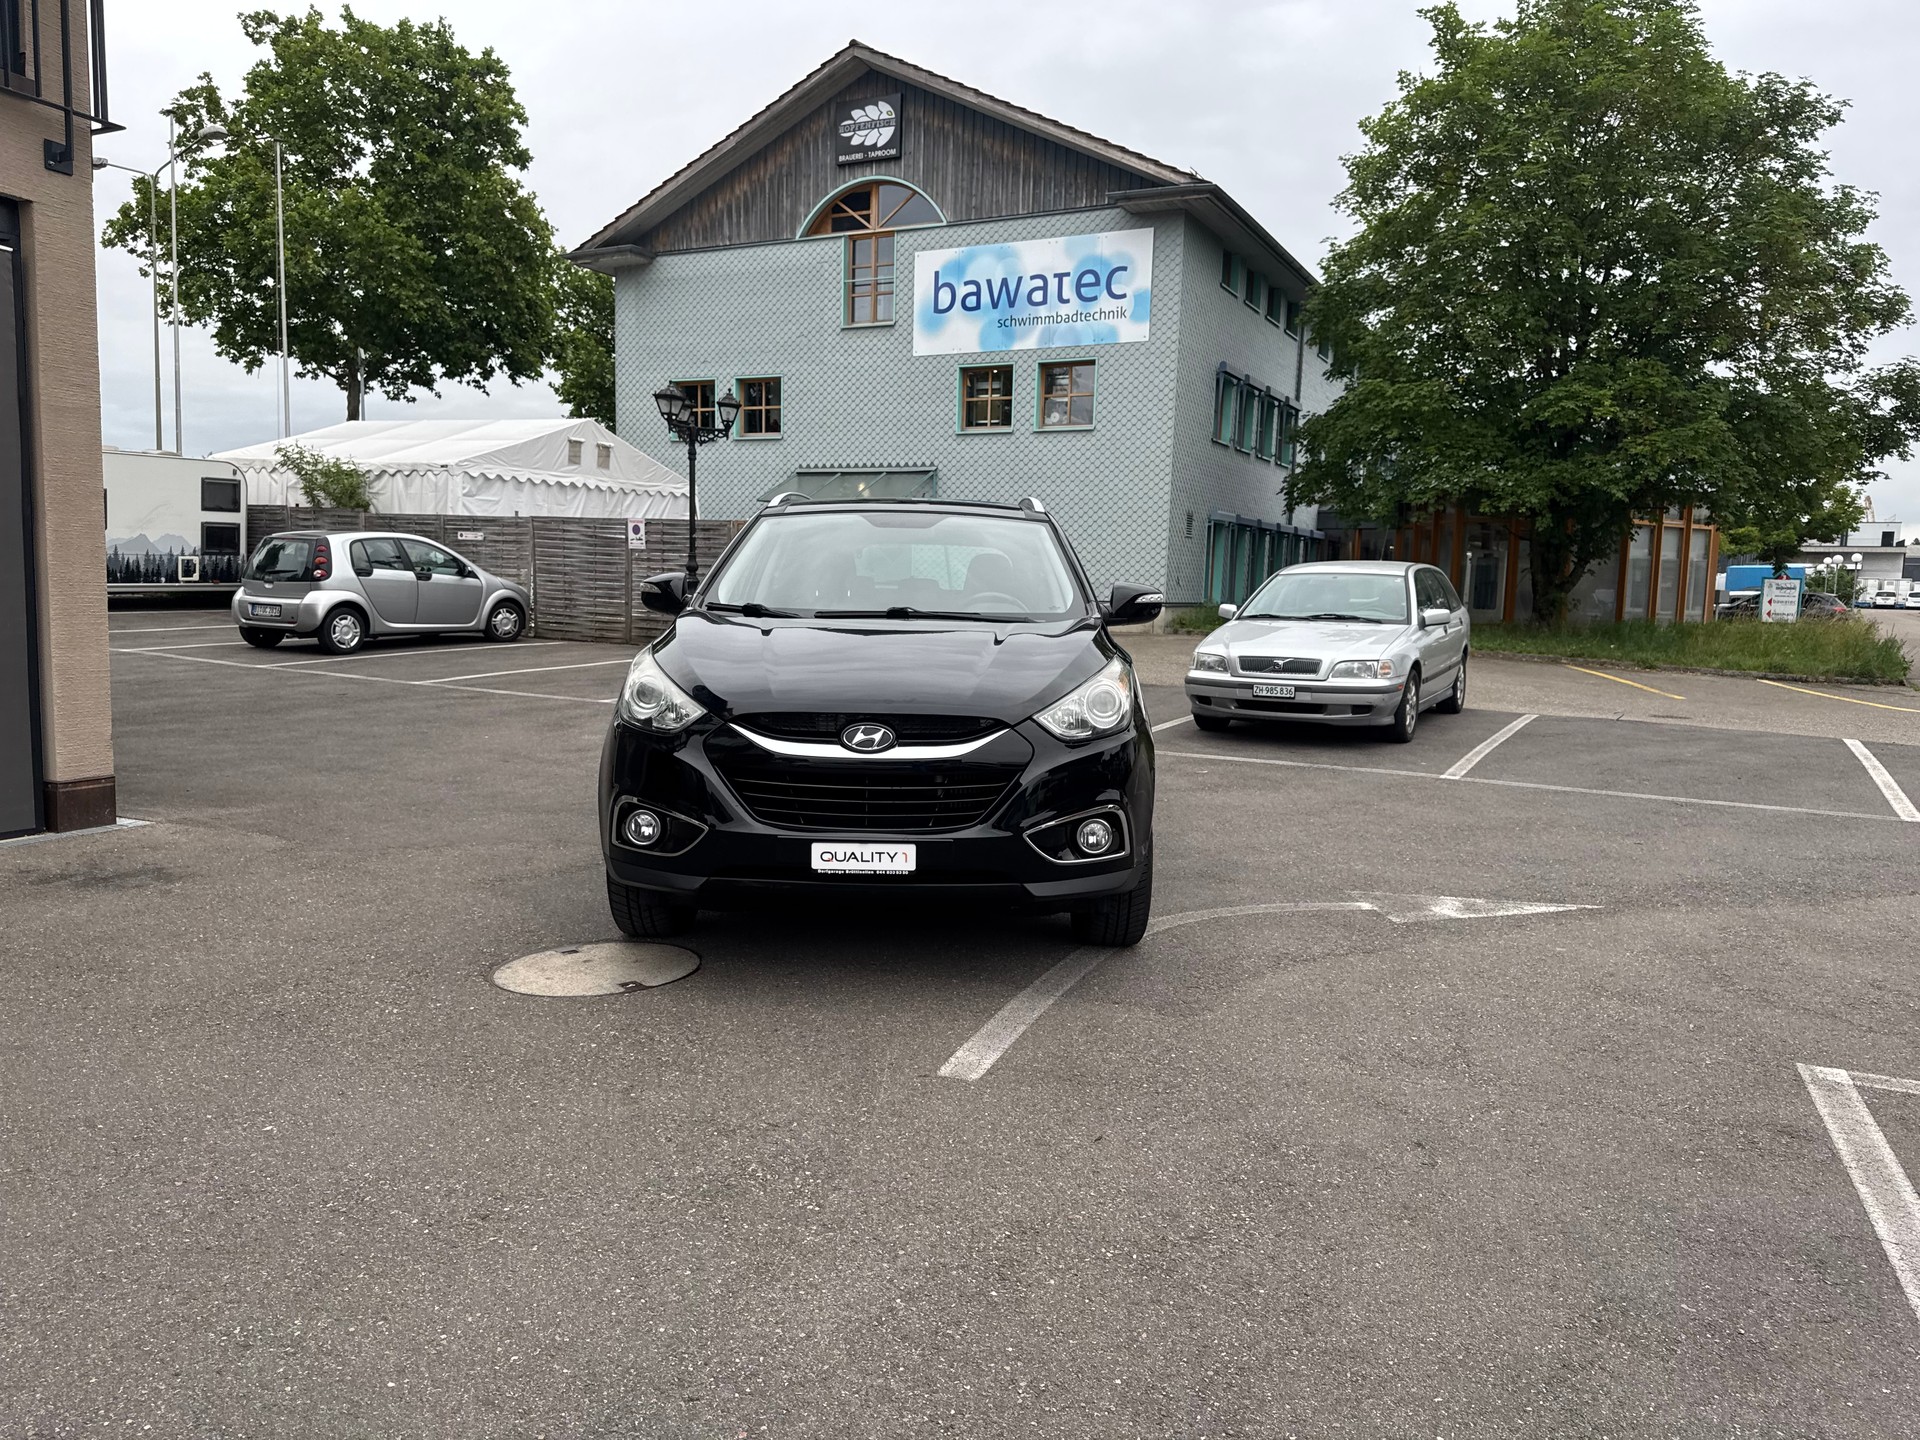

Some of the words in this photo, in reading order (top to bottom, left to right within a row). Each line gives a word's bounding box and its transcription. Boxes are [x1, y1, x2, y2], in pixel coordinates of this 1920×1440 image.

[839, 153, 863, 162] BRAUEREI
[868, 148, 896, 158] TAPROOM
[932, 265, 1128, 315] bawatec
[997, 306, 1127, 329] schwimmbadtechnik
[820, 851, 898, 863] QUALITY
[902, 852, 908, 863] 1
